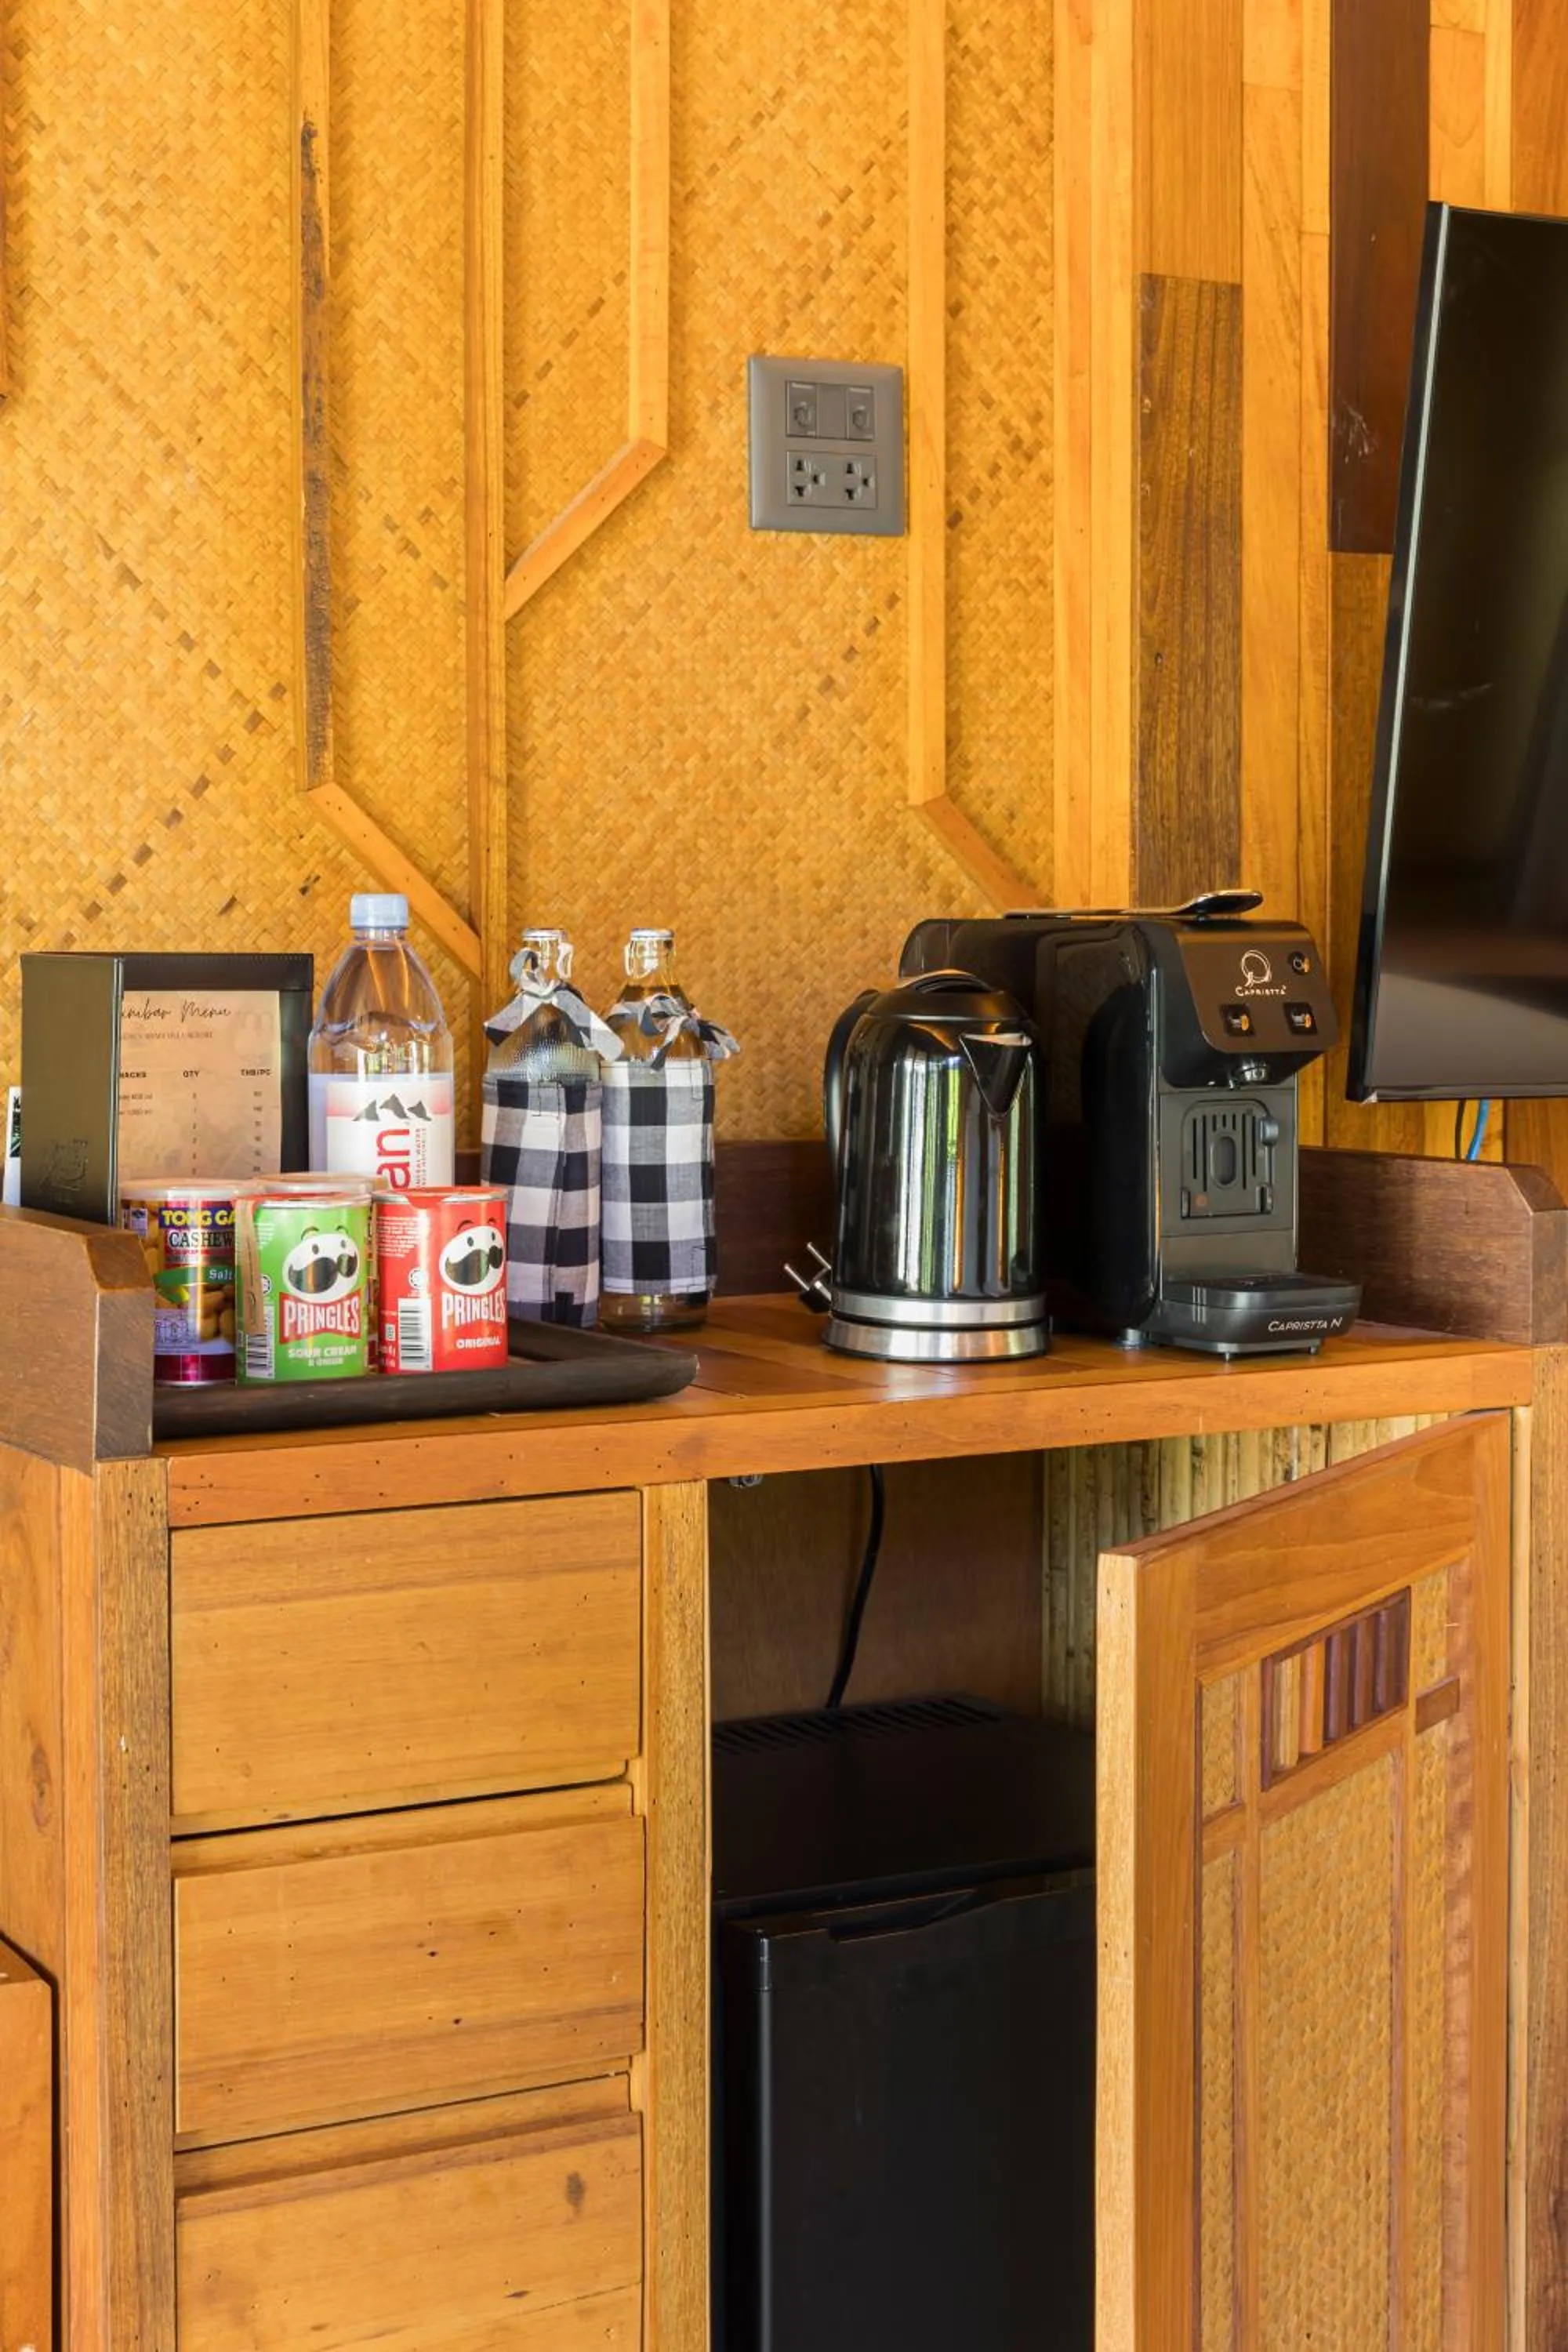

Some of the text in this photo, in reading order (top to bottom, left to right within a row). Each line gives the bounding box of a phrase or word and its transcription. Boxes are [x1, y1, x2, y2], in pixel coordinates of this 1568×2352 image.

[183, 1069, 200, 1078] QTY
[283, 1295, 359, 1338] PRINGLES
[441, 1288, 506, 1330] PRINGLES
[1268, 1316, 1343, 1332] CAPRISTTA N
[456, 1336, 501, 1349] ORIGINAL
